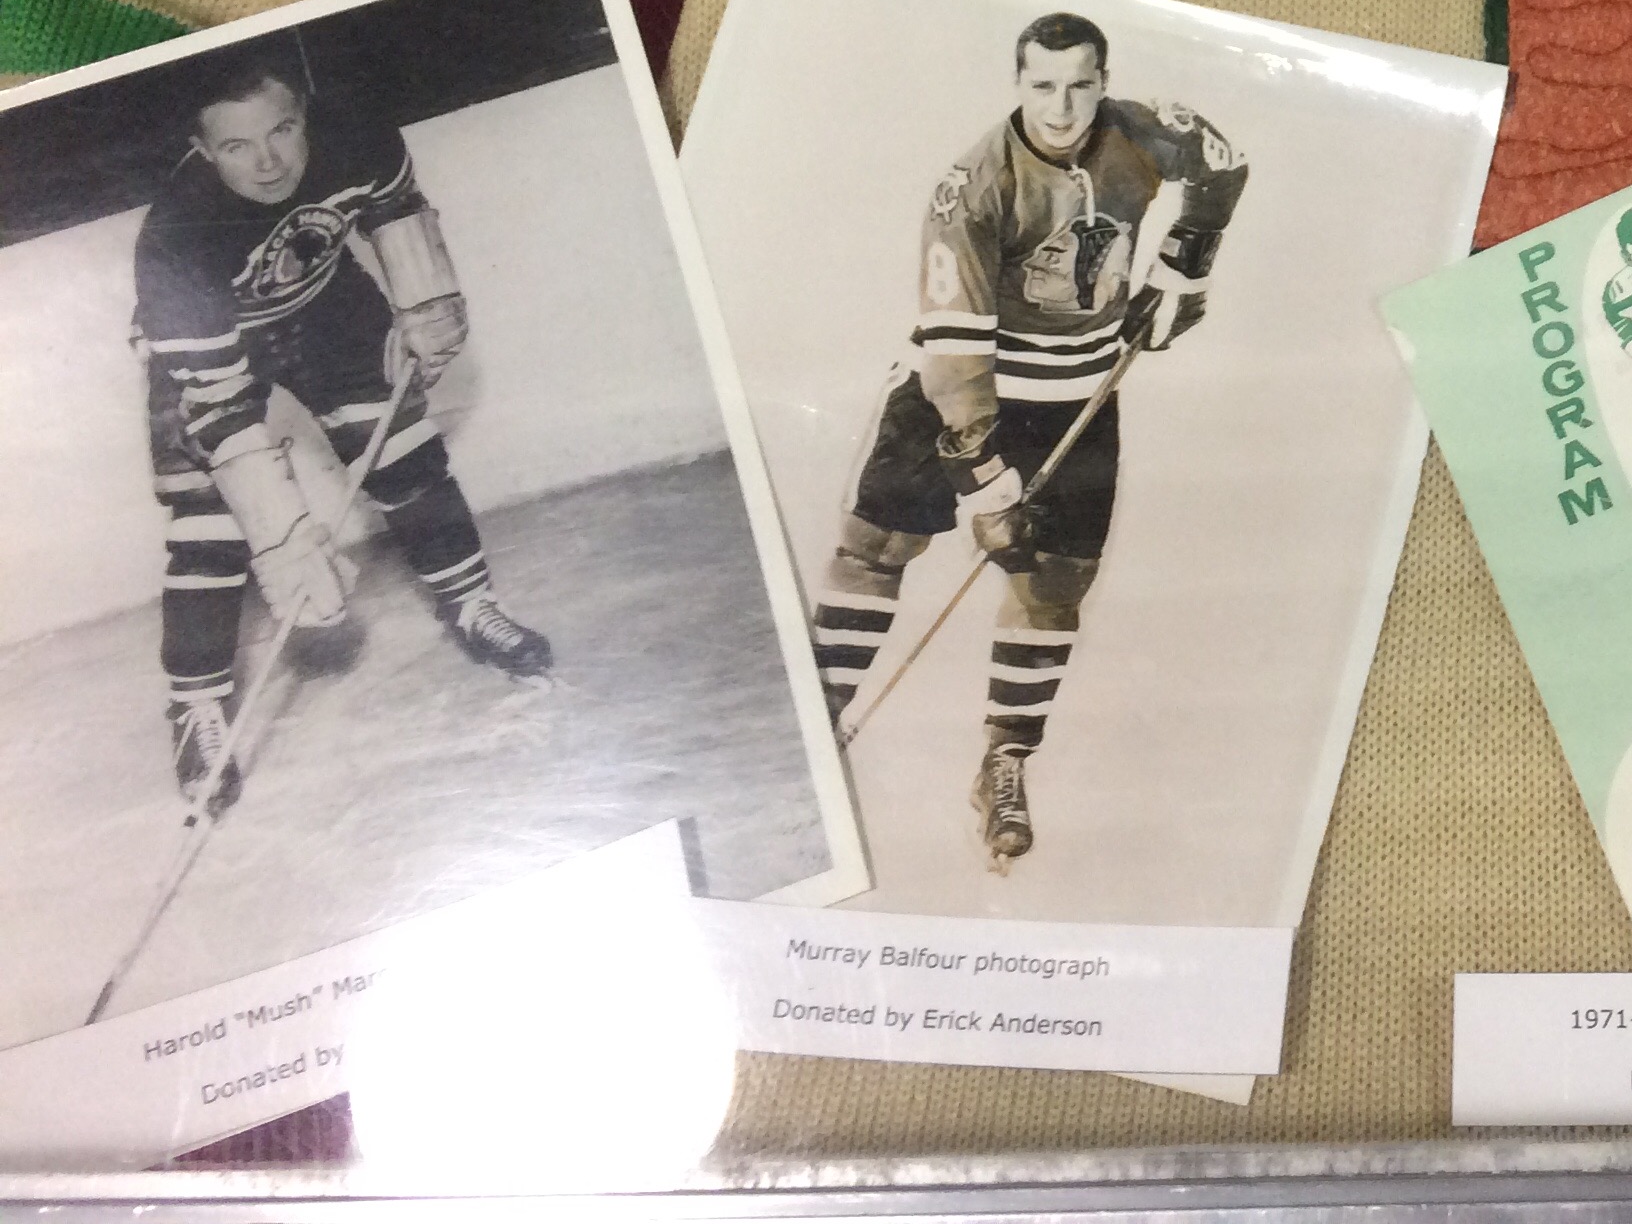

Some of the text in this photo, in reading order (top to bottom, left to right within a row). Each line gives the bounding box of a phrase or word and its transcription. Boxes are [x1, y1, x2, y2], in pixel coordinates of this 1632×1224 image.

[1517, 239, 1614, 527] PROGRAM
[785, 938, 1111, 980] Murray Balfour photograph
[143, 1017, 228, 1062] Harold
[331, 968, 387, 1000] Mar
[772, 997, 1103, 1037] Donated by Erick Anderson
[200, 1042, 345, 1105] Donated by
